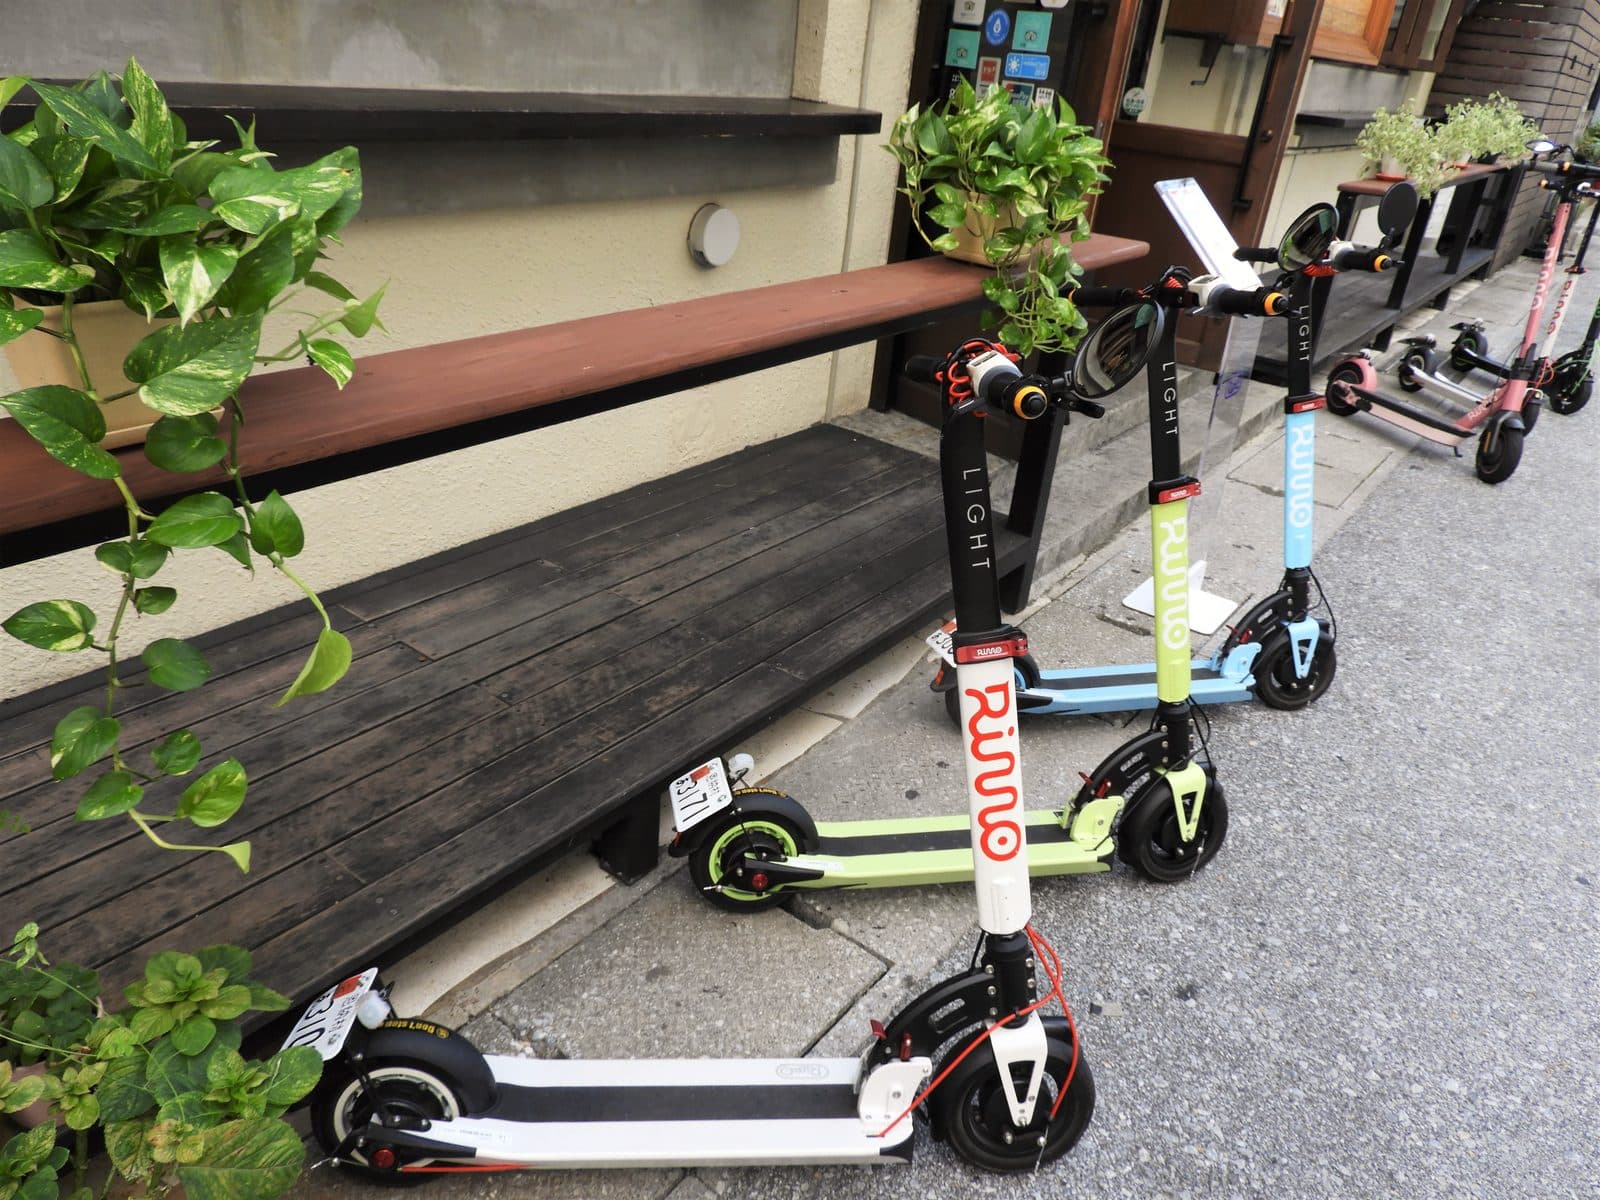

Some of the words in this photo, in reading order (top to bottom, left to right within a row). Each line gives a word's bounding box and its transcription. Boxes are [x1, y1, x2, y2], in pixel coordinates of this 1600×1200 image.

[1299, 305, 1310, 361] LIGHT
[1162, 361, 1178, 435] LIGHT
[962, 467, 991, 570] LIGHT
